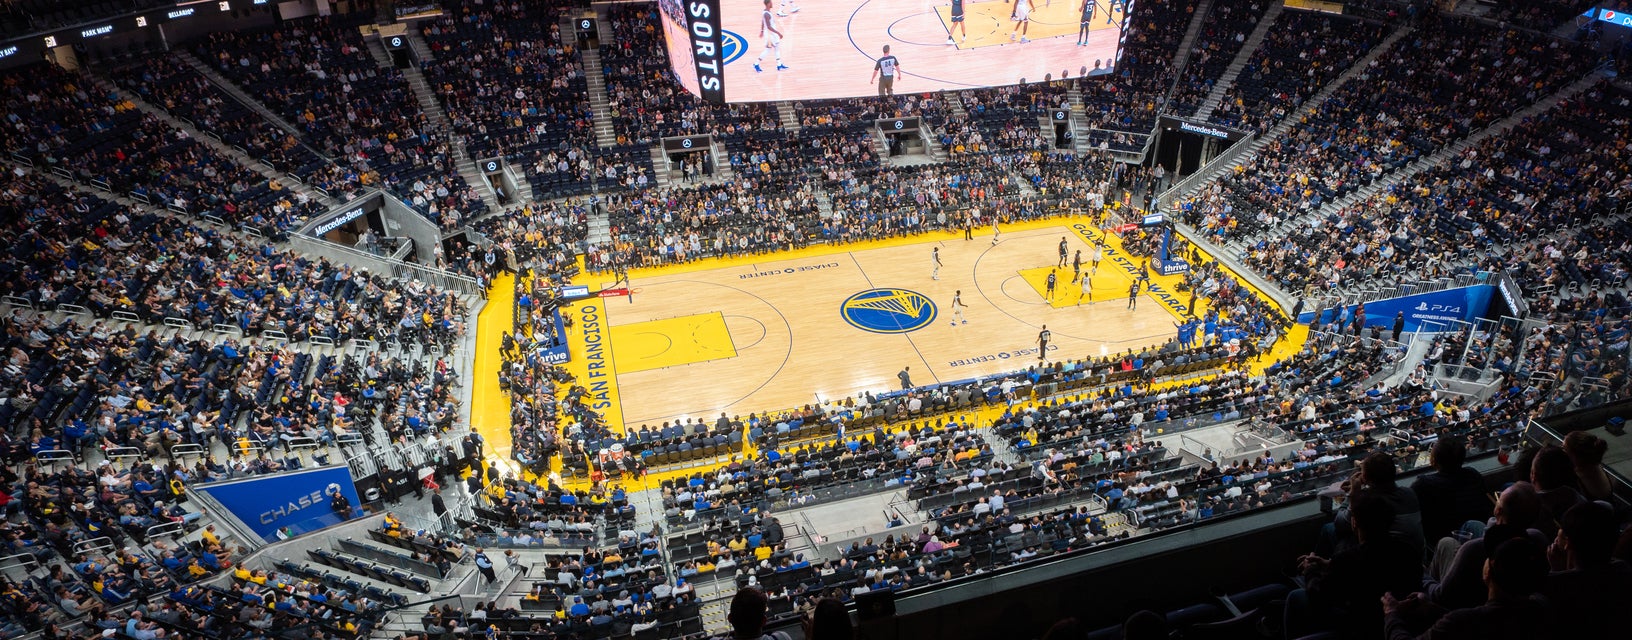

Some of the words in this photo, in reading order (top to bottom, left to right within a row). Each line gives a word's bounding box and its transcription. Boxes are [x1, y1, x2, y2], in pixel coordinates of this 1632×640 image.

[82, 29, 97, 38] PARK
[690, 2, 720, 91] SORTS
[1181, 121, 1228, 138] Mercedes-Benz
[315, 208, 363, 237] Mercedes-Benz
[1073, 223, 1119, 256] GOLEN
[739, 270, 781, 279] CENTER
[798, 262, 839, 272] CHASE
[1164, 262, 1188, 272] thrive
[1431, 304, 1461, 313] PS4
[581, 305, 607, 378] FRANCISCO
[533, 352, 567, 363] rive
[949, 354, 996, 367] CENTER
[590, 380, 611, 409] SAN
[260, 489, 324, 525] CHASE
